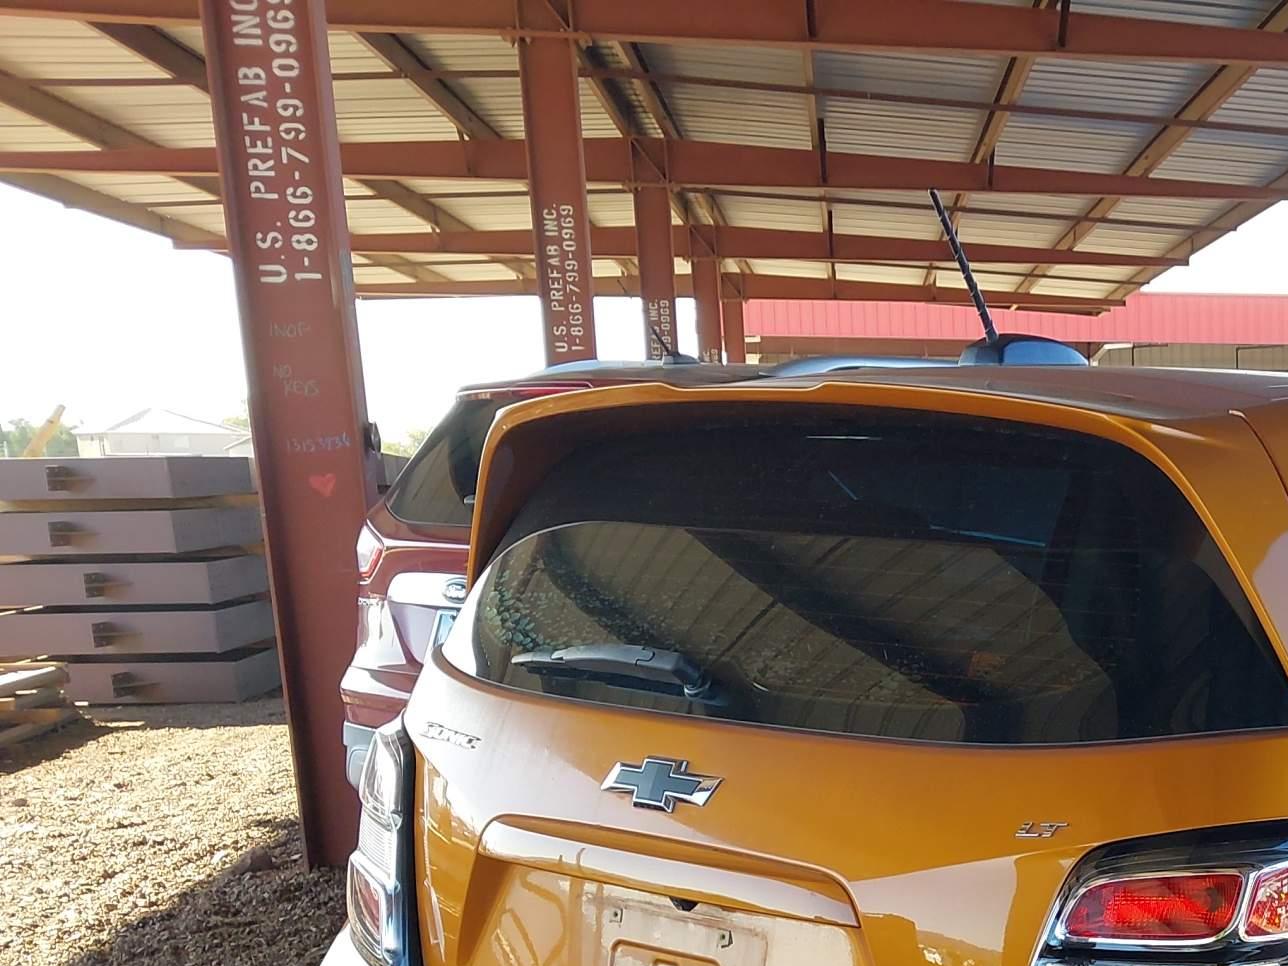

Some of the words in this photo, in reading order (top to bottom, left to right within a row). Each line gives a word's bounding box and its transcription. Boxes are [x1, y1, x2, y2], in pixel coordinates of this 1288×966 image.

[238, 66, 279, 199] PREFAB
[266, 0, 322, 281] 1-866-799-096
[543, 203, 559, 236] INC.
[256, 221, 288, 283] U.S.
[546, 244, 565, 311] PREFAB
[559, 204, 585, 351] 1-866-799-0969
[553, 321, 569, 352] U.S.
[1015, 821, 1070, 838] LT
